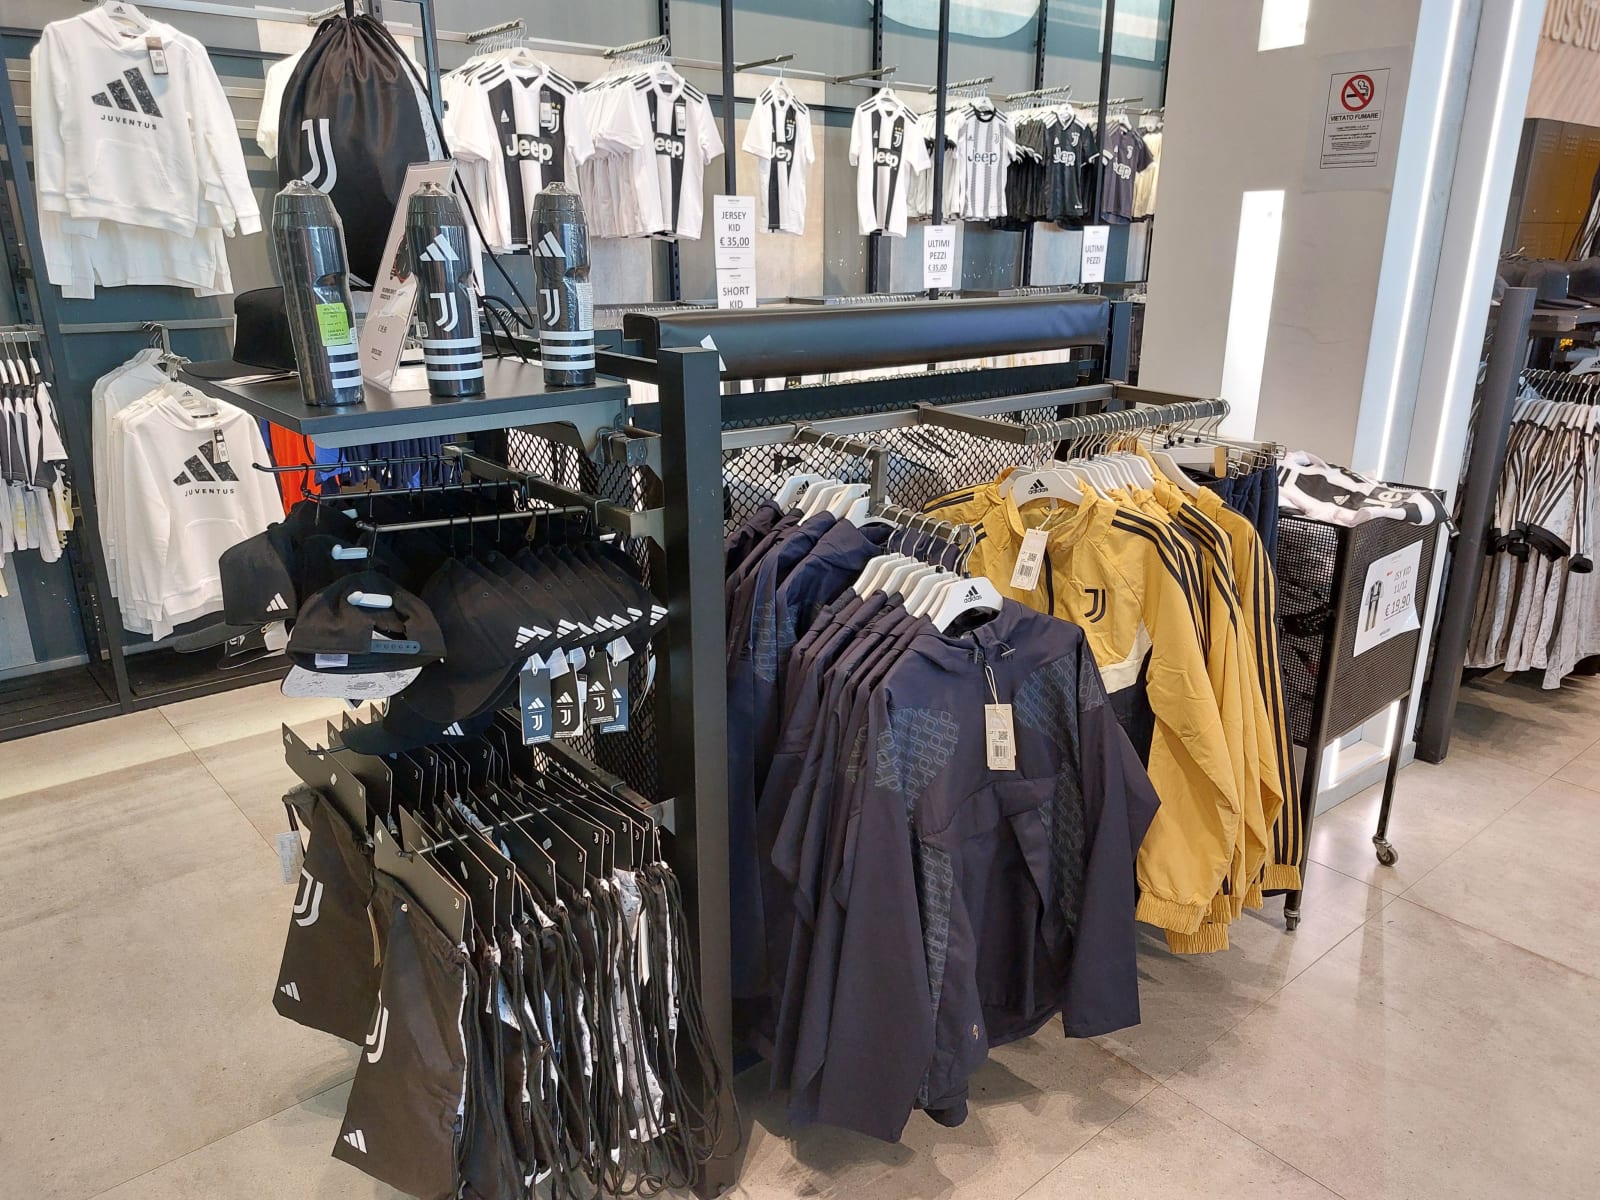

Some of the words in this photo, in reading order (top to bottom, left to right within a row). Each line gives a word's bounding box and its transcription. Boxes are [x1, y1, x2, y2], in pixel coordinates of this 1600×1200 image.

[1354, 112, 1379, 120] FUMARE
[100, 114, 158, 131] JUVENTUS
[506, 133, 553, 165] Jeep
[654, 136, 684, 159] eep
[967, 148, 998, 166] Jeep
[722, 211, 747, 220] JERSEY
[728, 223, 741, 232] KID
[719, 236, 726, 246] €
[727, 236, 750, 247] 35,00
[927, 239, 950, 248] ULTIMI
[929, 251, 947, 259] PEZZI
[722, 286, 750, 297] SHORT
[729, 300, 743, 309] KID
[184, 488, 235, 497] JUVENTUS
[1028, 487, 1049, 495] adidas
[963, 594, 983, 604] adidas
[1391, 593, 1411, 613] 19,90
